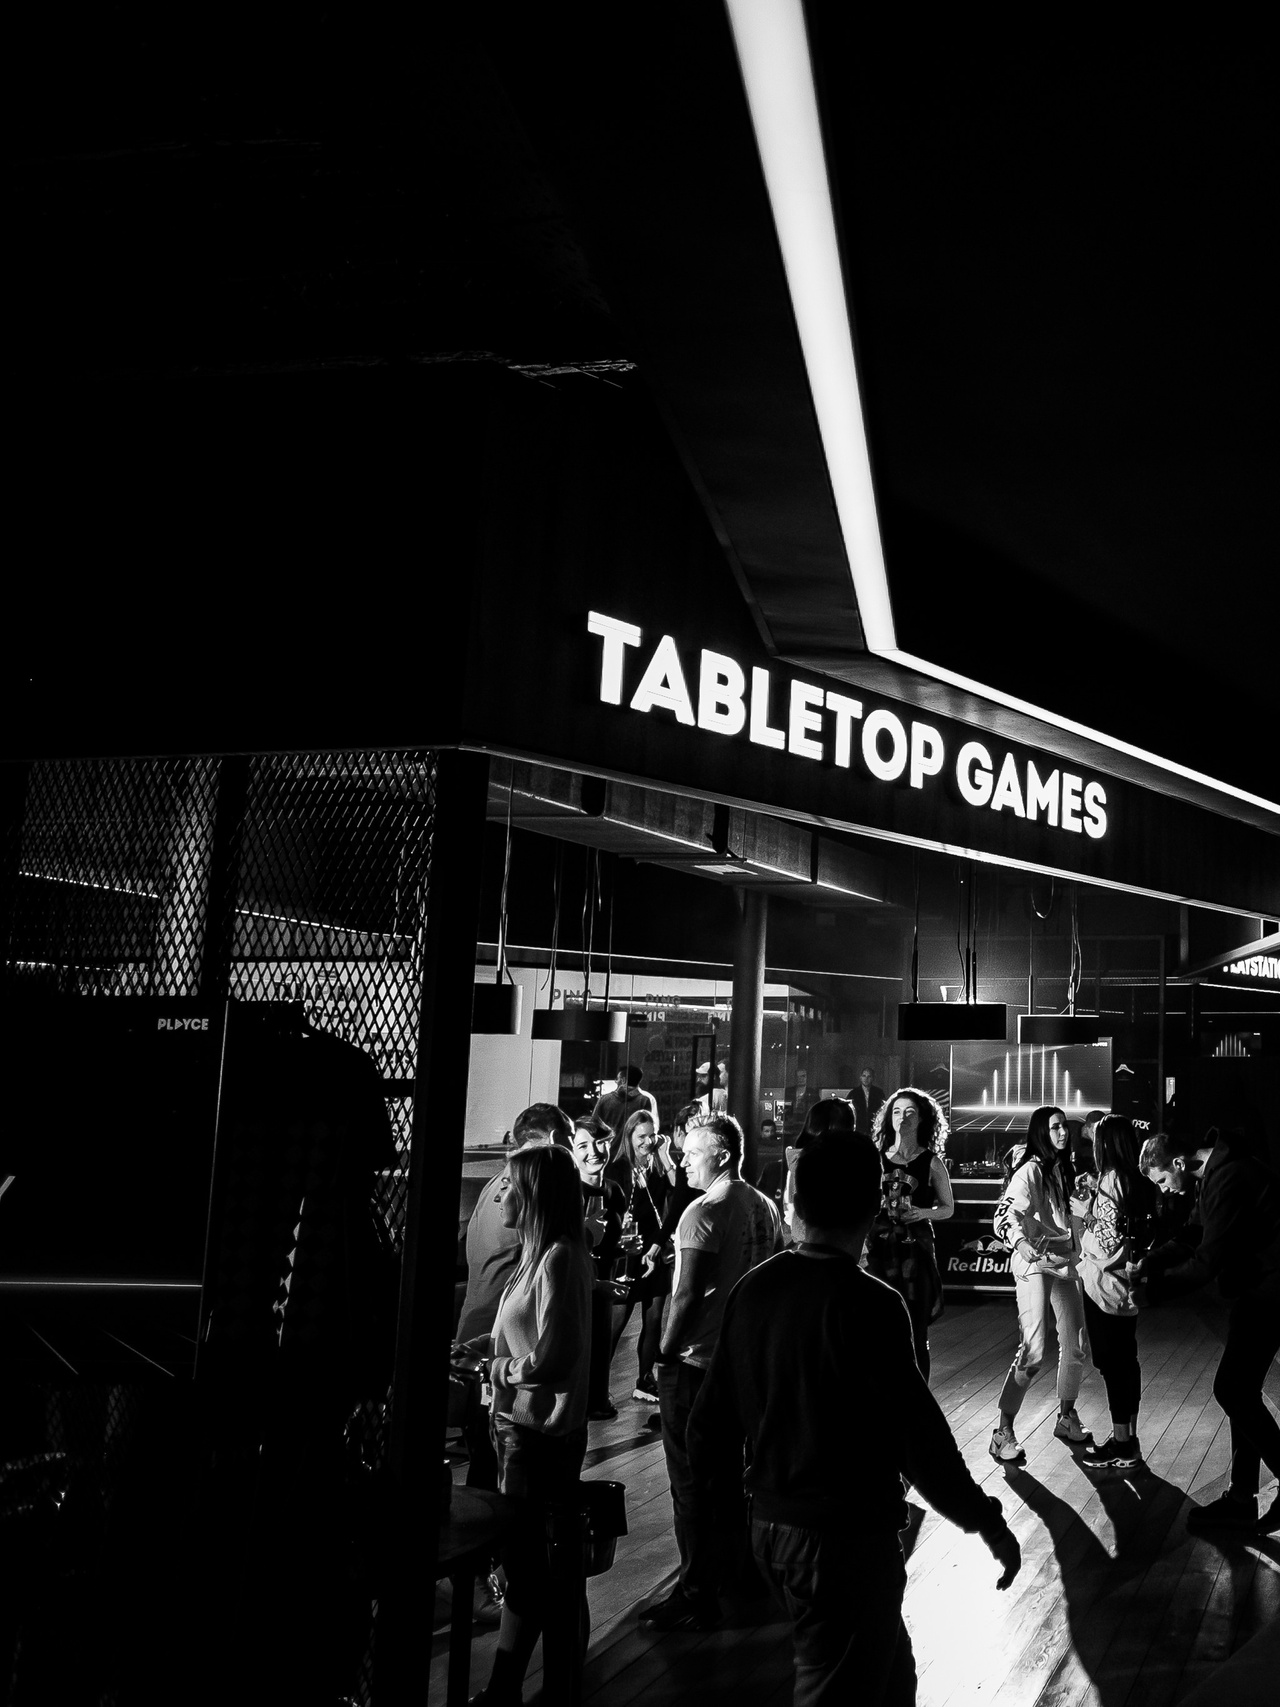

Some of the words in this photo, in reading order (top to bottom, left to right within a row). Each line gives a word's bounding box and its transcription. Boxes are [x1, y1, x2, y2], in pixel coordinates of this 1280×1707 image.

[588, 610, 944, 789] TABLETOP
[956, 741, 1108, 839] GAMES
[947, 1256, 982, 1273] Red
